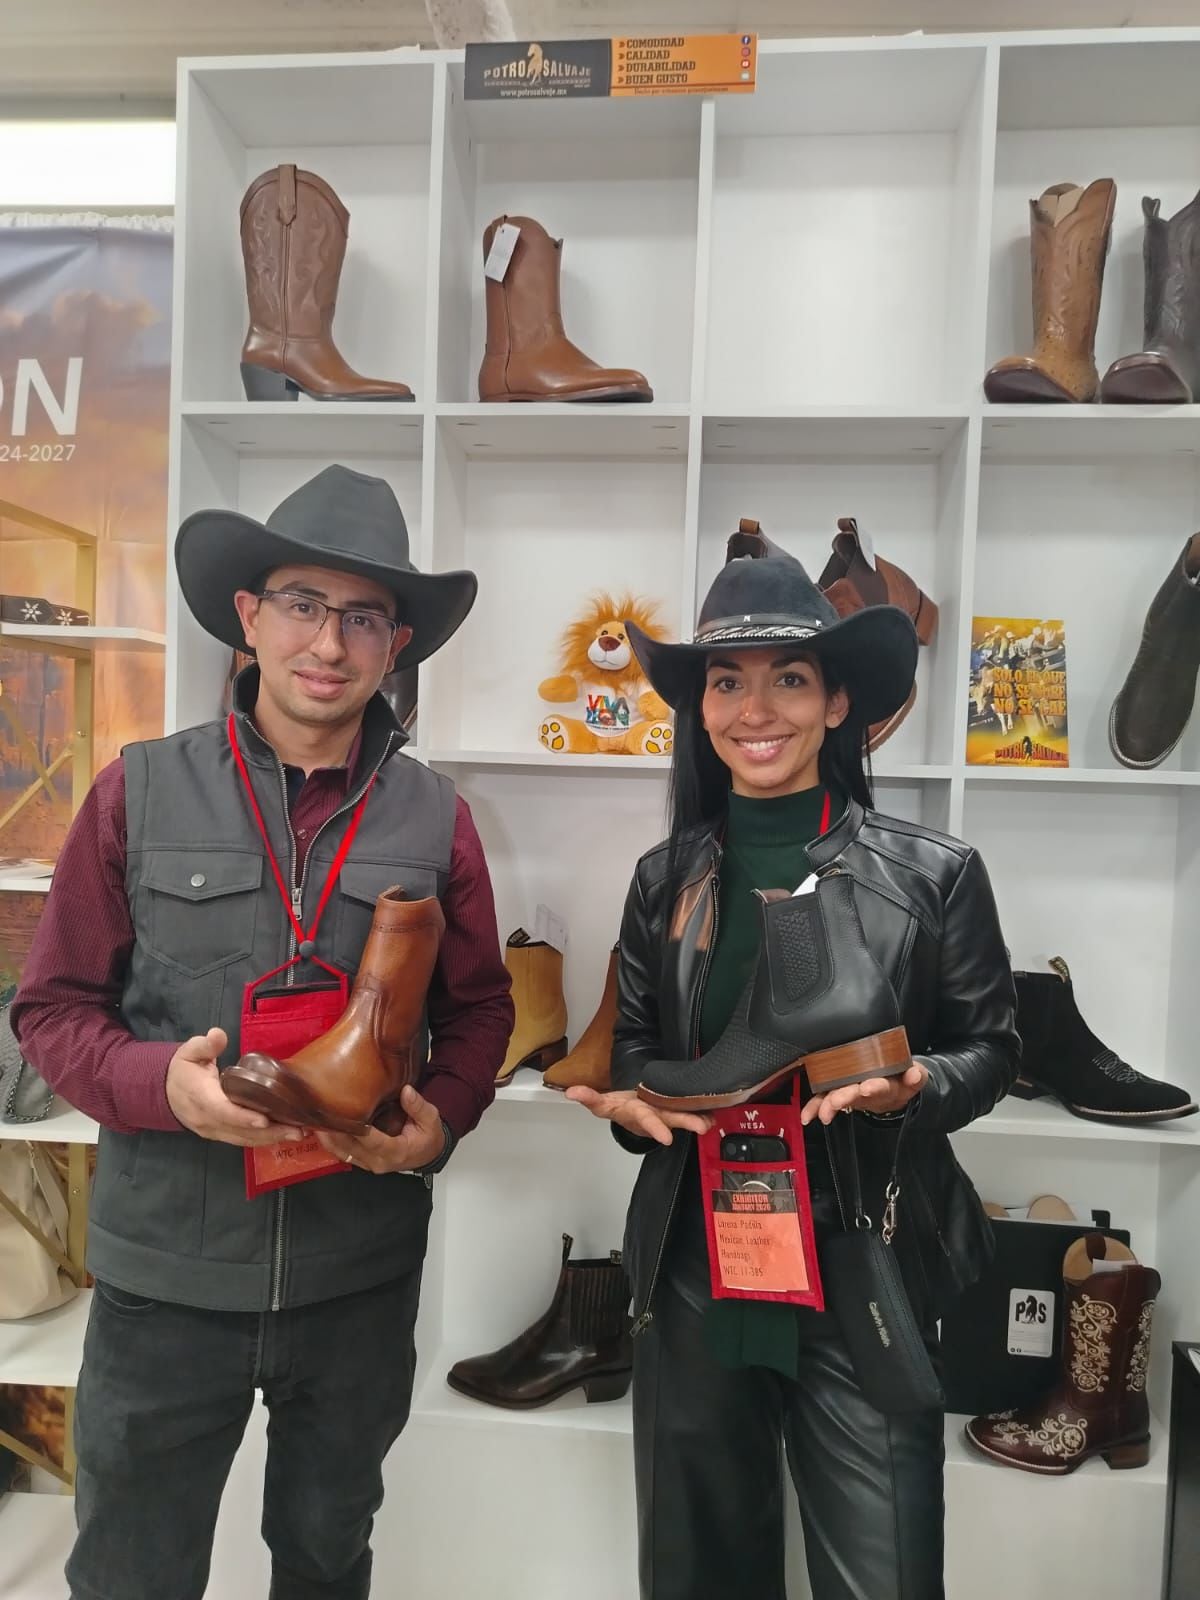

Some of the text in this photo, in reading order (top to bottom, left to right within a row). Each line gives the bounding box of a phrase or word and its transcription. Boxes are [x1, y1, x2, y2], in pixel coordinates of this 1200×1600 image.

[626, 37, 685, 49] COMODIDAD
[626, 50, 670, 61] CALIDAD
[483, 59, 591, 79] POTRO SALVAJE
[626, 61, 696, 72] DURABILIDAD
[625, 73, 688, 84] BUEN GUSTO
[500, 87, 567, 98] www.potrosalvaje.mx
[0, 356, 83, 436] N
[992, 668, 1022, 683] SOLO
[993, 683, 1013, 697] NO
[1016, 684, 1030, 698] SE
[993, 698, 1014, 714] NO
[1018, 700, 1033, 715] SE
